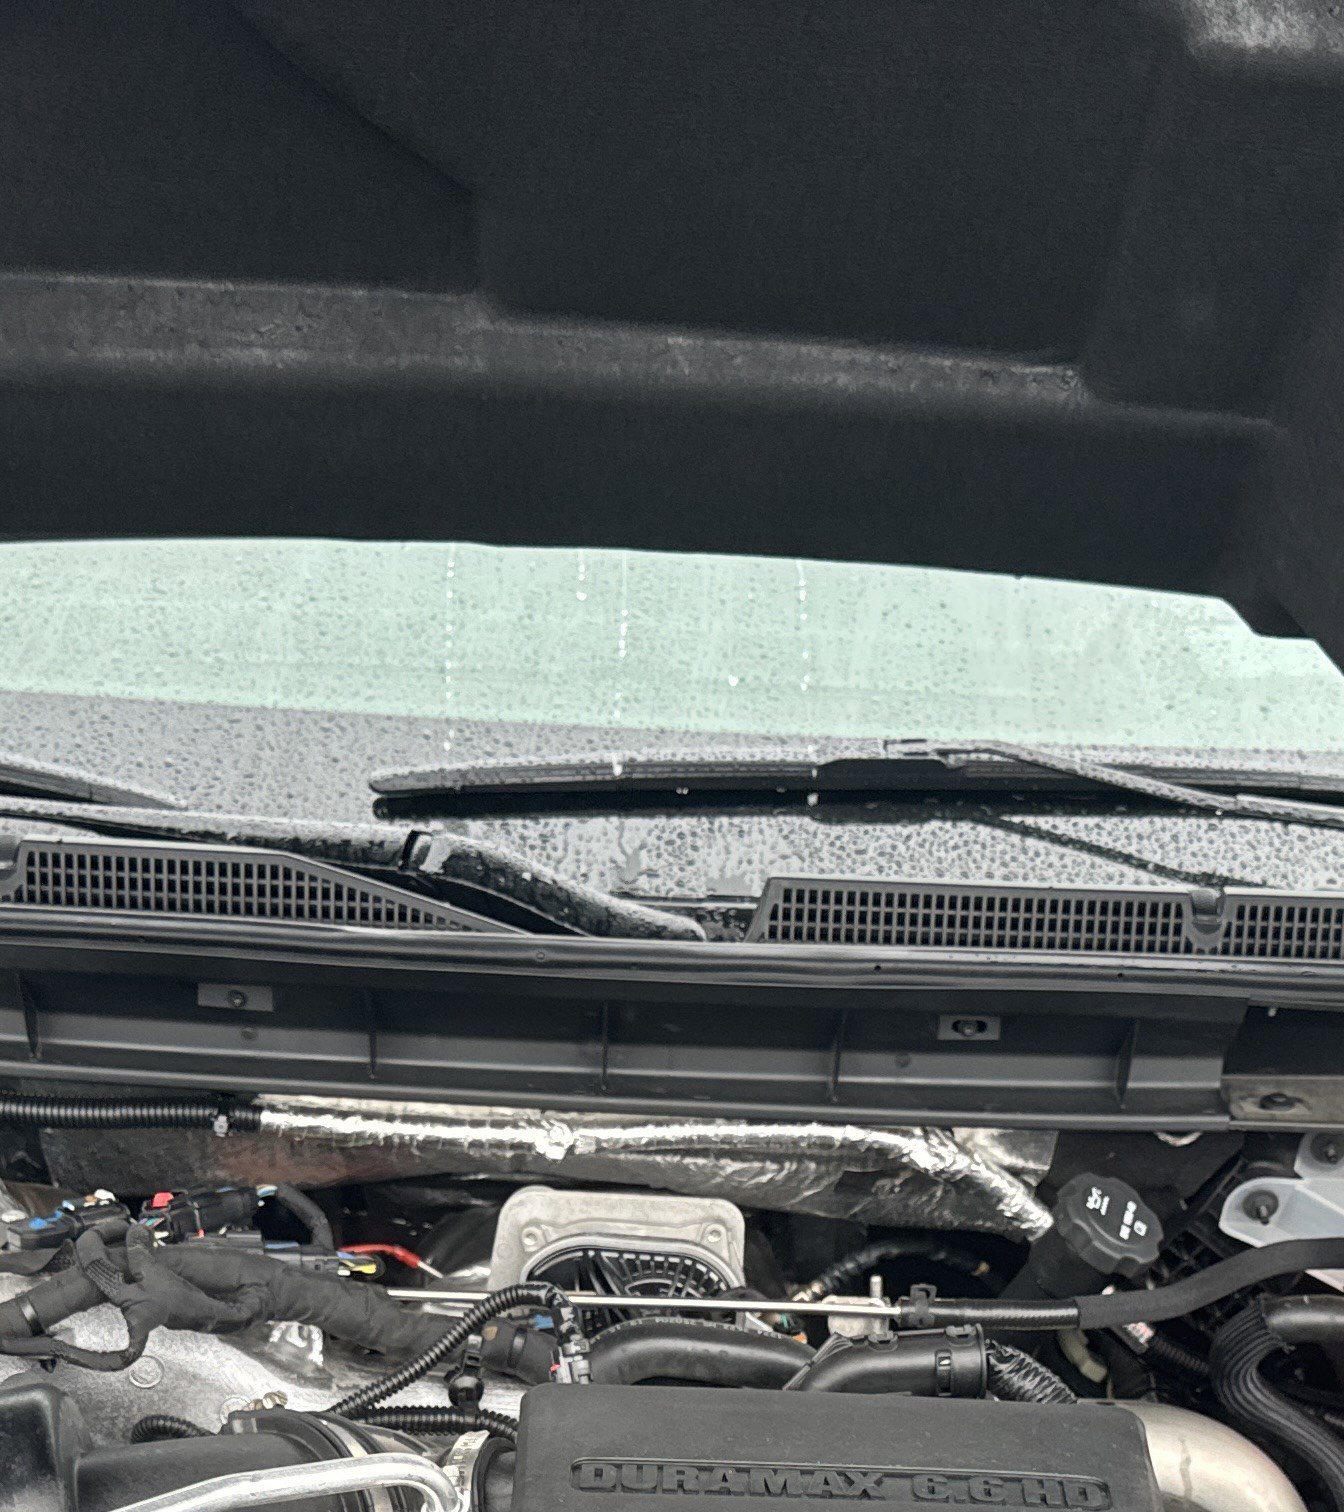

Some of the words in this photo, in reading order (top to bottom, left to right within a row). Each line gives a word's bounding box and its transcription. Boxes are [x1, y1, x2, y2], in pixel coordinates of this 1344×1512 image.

[580, 1463, 886, 1500] DURAMAX
[911, 1473, 1007, 1504] 6.6
[1021, 1478, 1108, 1511] HD
